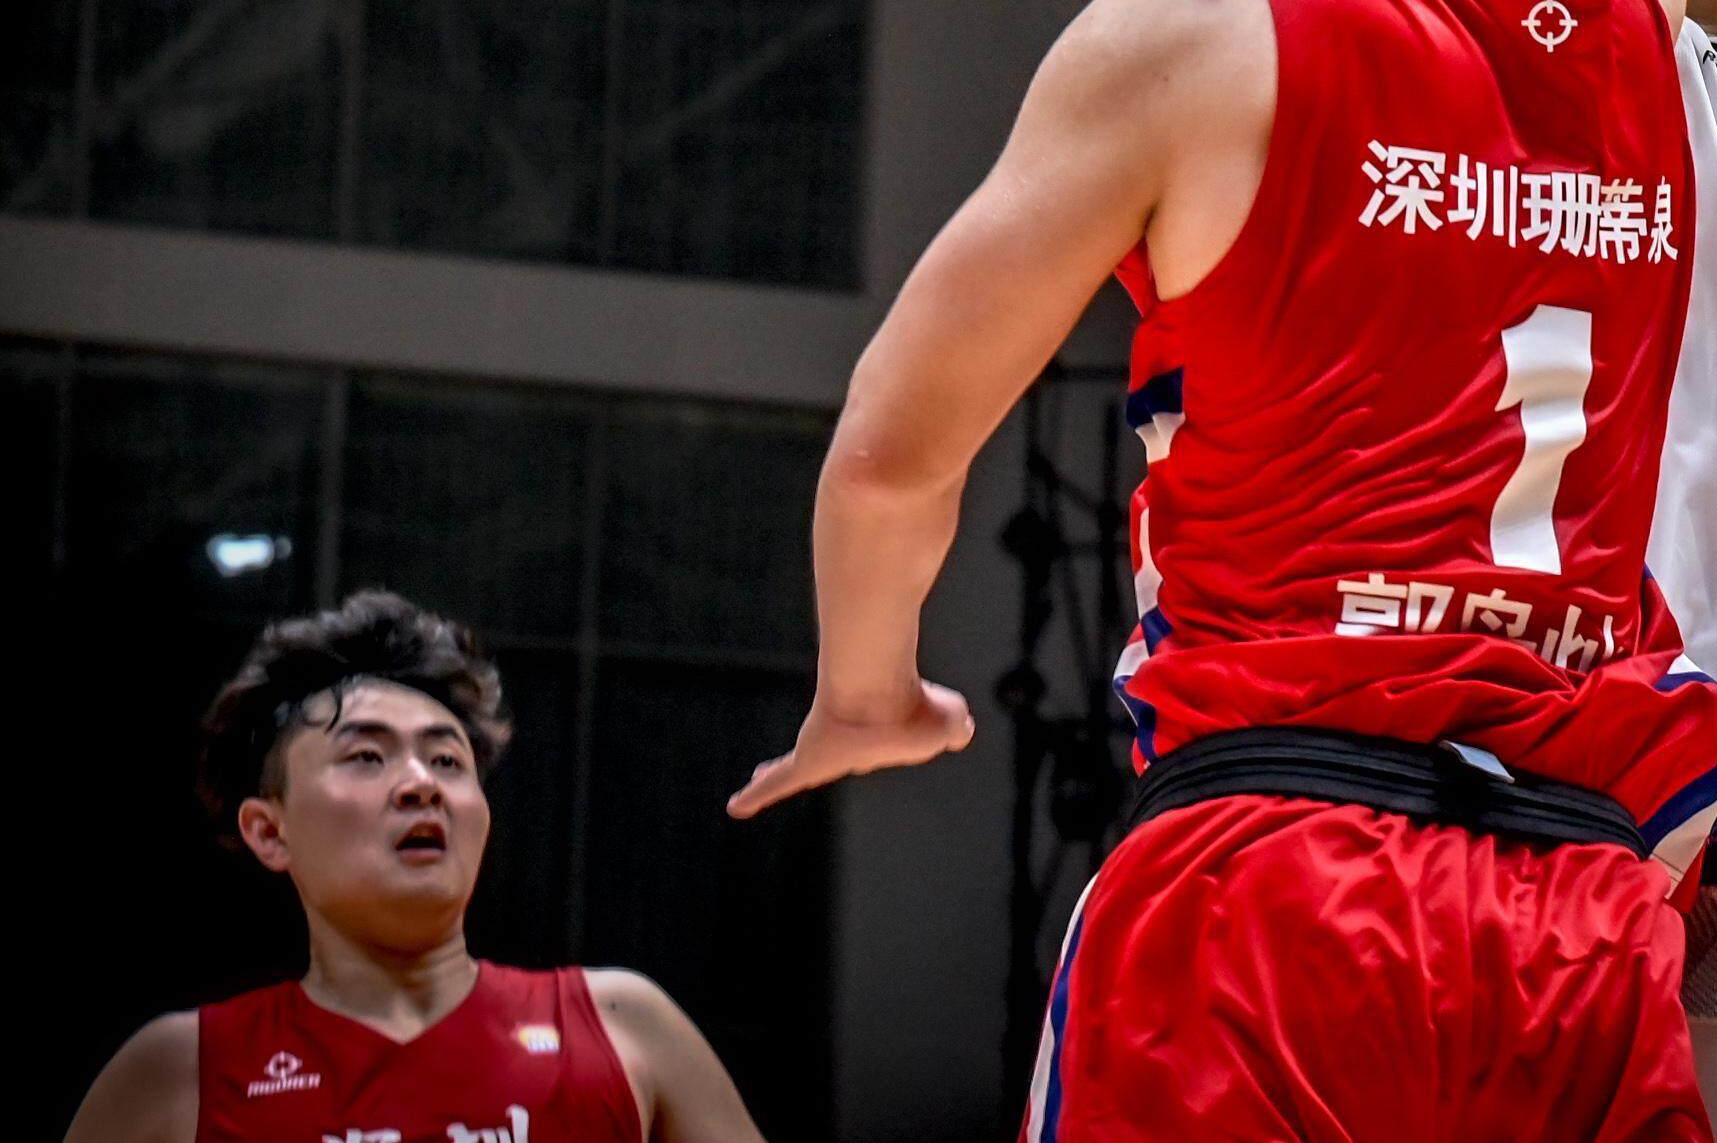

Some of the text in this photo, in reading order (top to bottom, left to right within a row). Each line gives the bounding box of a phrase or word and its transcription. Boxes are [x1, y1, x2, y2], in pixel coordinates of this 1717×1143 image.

[1358, 139, 1679, 265] 深圳珊蒂泉
[1489, 303, 1593, 576] 1
